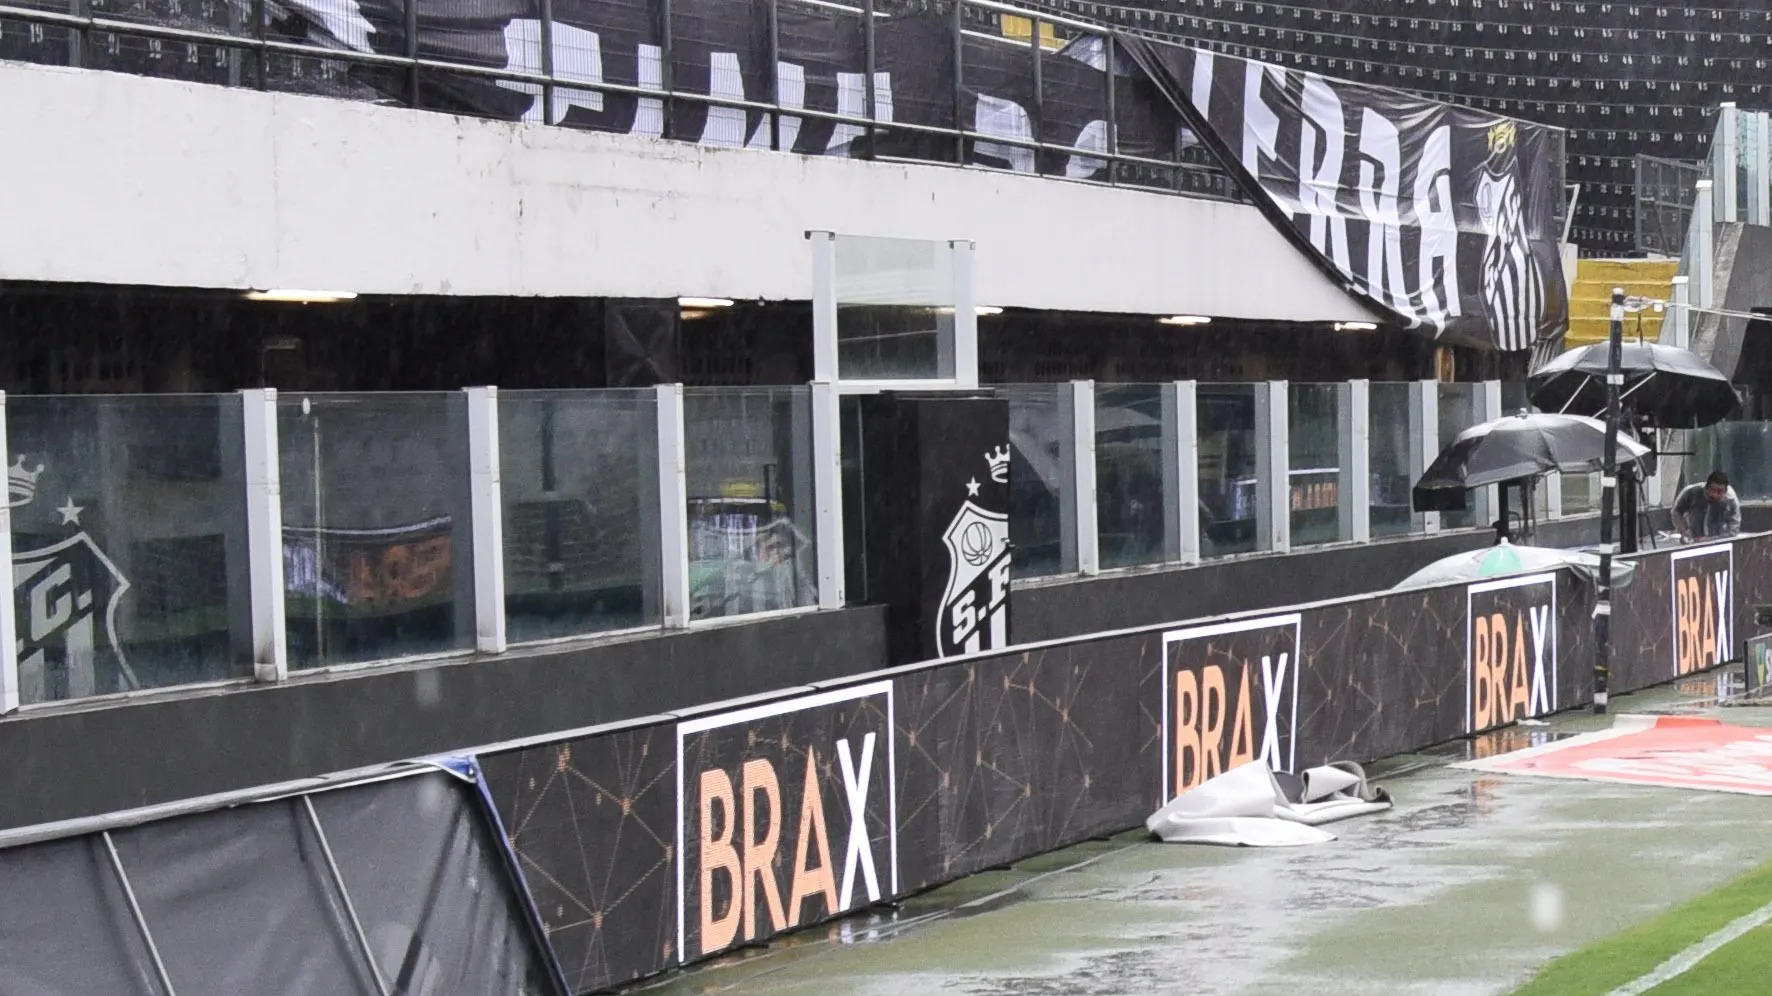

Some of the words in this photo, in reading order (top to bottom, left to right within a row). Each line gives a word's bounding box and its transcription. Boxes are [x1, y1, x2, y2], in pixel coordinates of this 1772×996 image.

[1475, 605, 1548, 730] BRAX
[1677, 570, 1729, 674] BRAX
[1176, 652, 1288, 796] BRAX
[699, 731, 880, 955] BRAX
